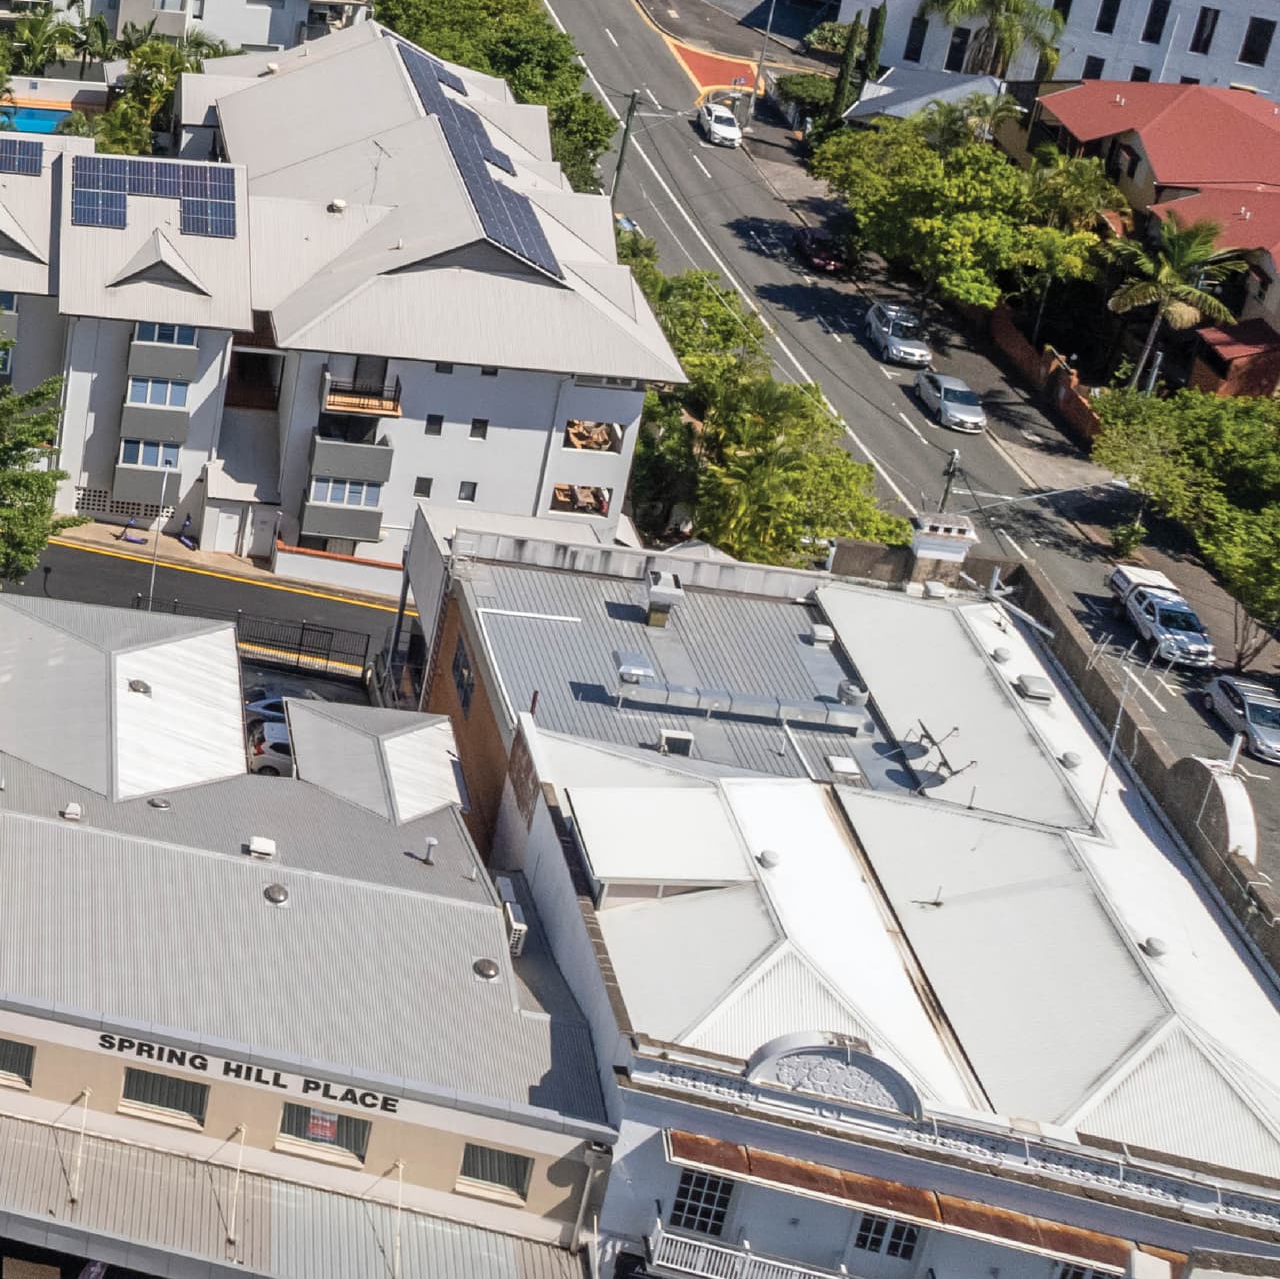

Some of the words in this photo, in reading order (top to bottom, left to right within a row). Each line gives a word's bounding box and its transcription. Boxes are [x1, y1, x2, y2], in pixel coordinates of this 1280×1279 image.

[98, 1033, 209, 1071] SPRING
[222, 1060, 289, 1089] HILL
[301, 1078, 400, 1114] PLACE
